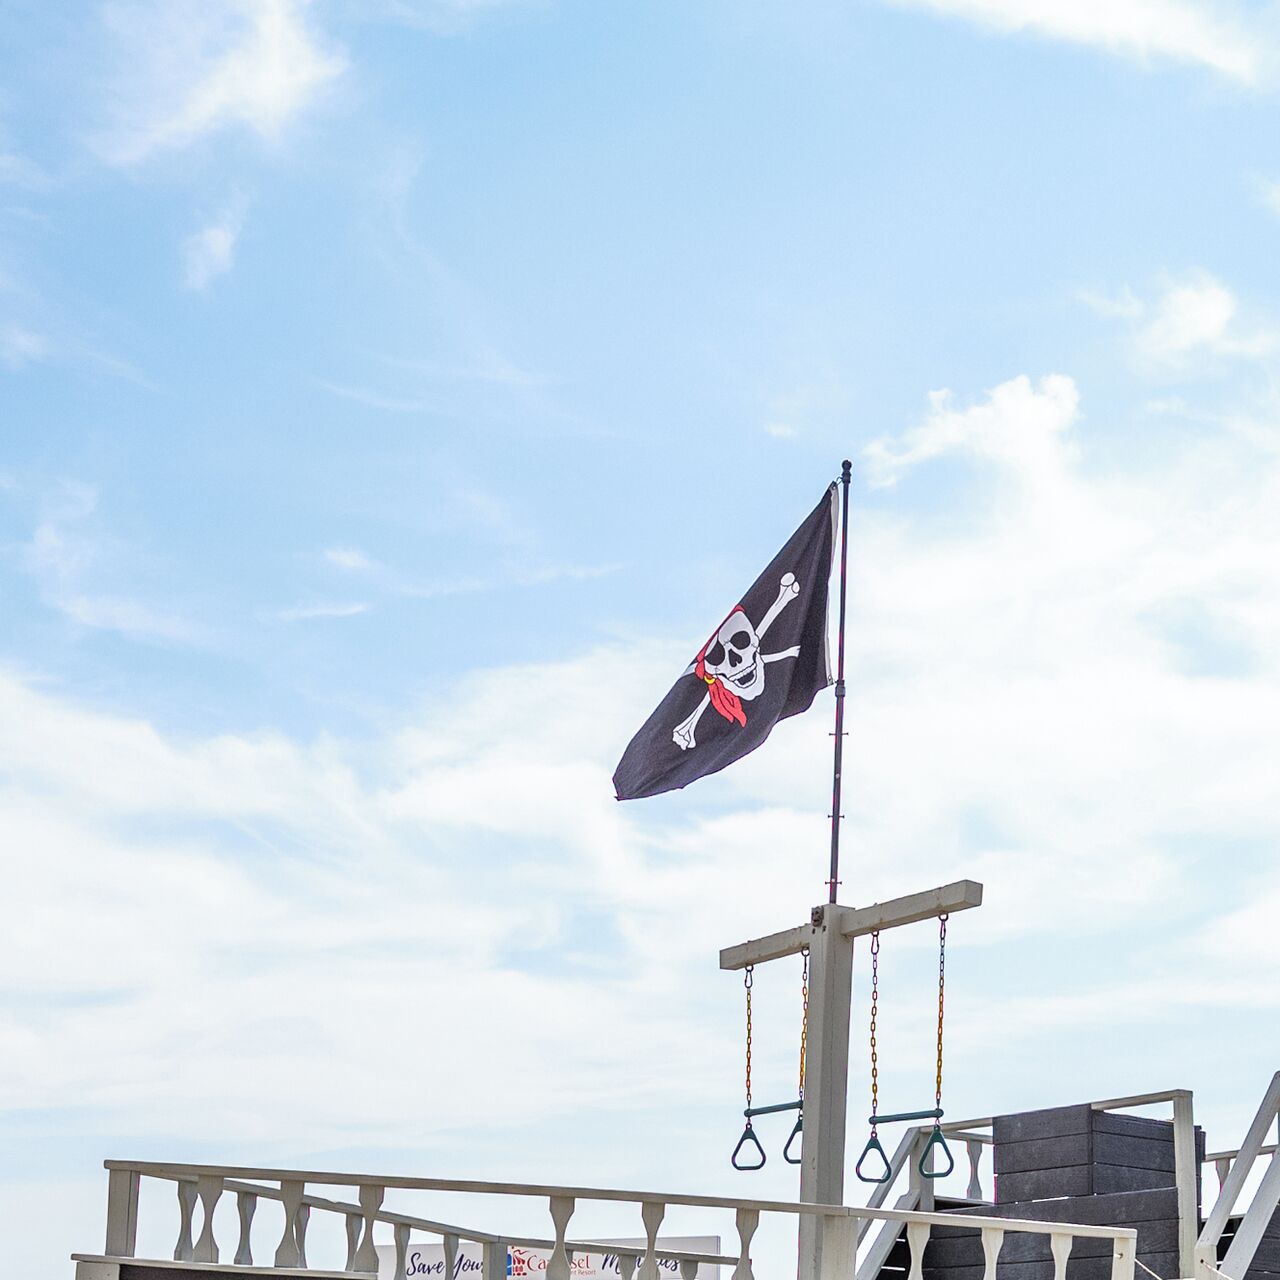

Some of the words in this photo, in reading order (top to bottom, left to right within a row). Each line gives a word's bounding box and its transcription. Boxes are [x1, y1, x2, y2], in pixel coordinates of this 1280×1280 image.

[406, 1252, 445, 1276] Save
[453, 1253, 483, 1280] You
[527, 1254, 590, 1271] Casel
